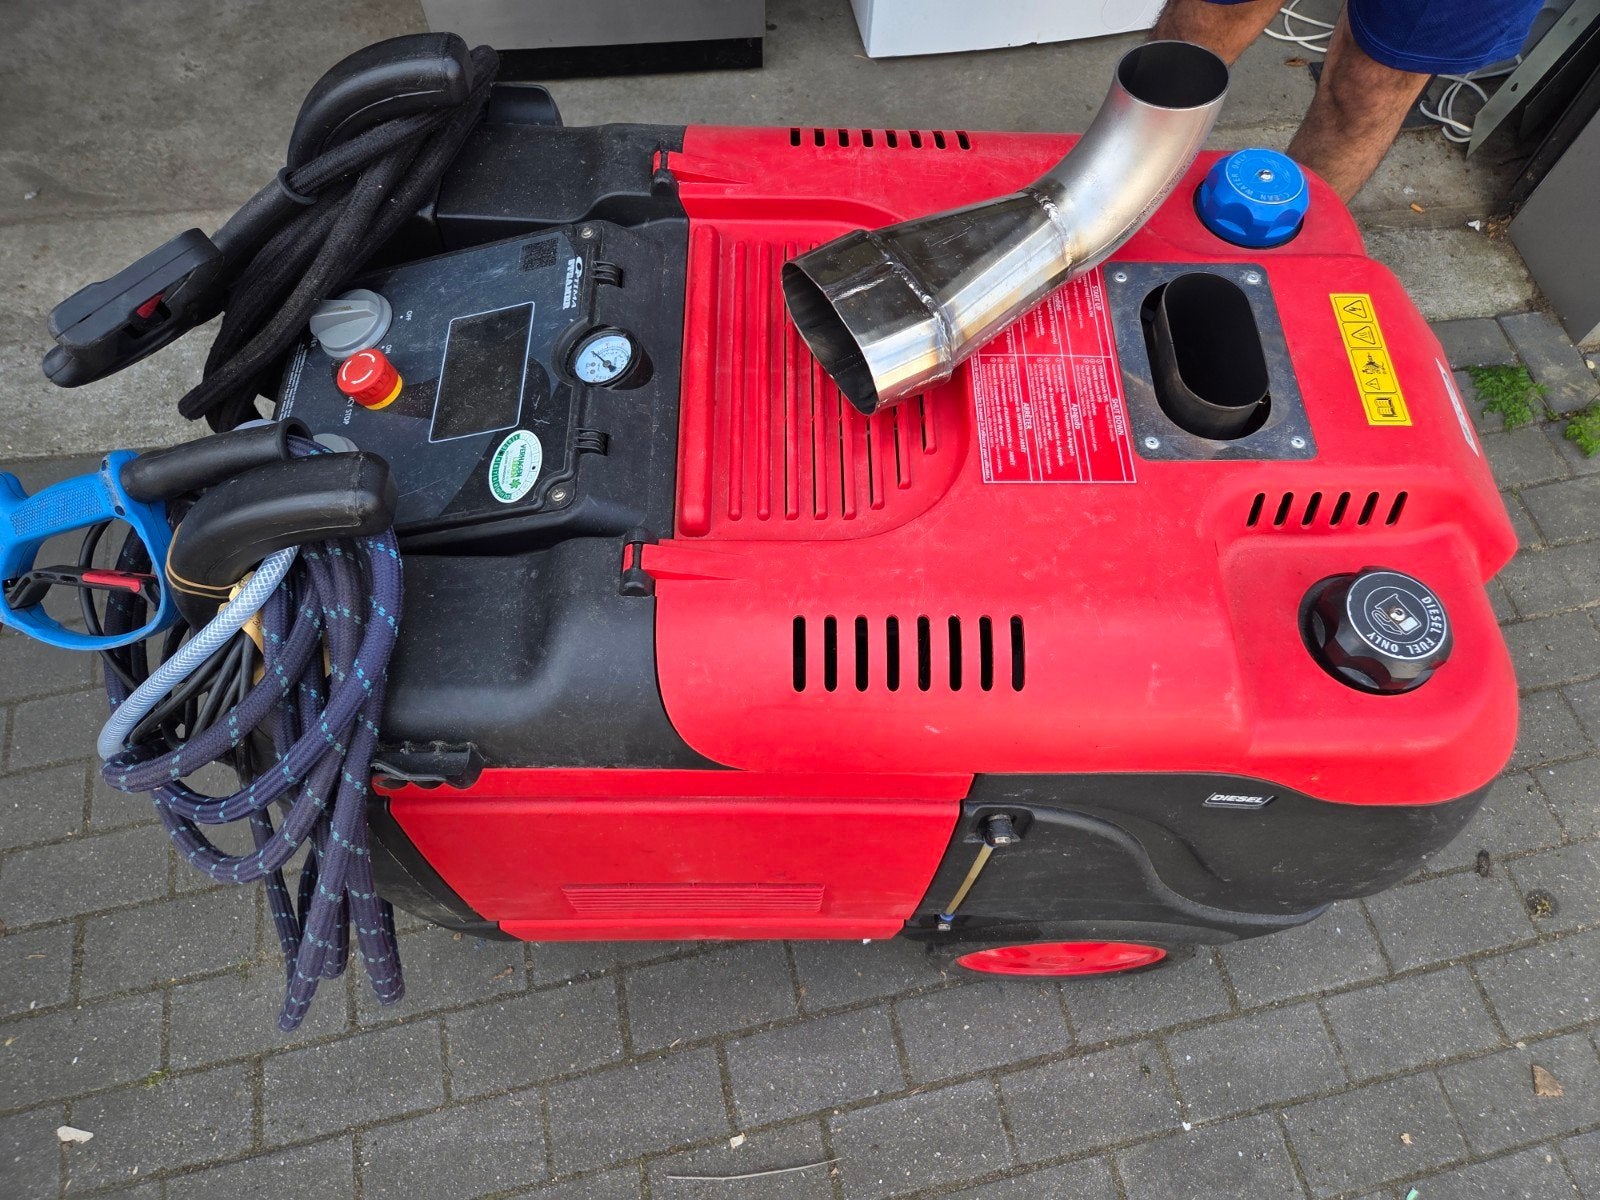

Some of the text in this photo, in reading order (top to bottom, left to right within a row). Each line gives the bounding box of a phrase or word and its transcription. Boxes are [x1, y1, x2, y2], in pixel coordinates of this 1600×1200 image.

[1232, 153, 1247, 169] ONLY
[1231, 174, 1254, 196] WATER
[1091, 285, 1102, 310] START UP
[405, 309, 413, 322] OFF
[385, 344, 393, 354] ON
[342, 408, 353, 425] STOP
[1022, 402, 1034, 429] ARRÊTER
[1070, 403, 1082, 429] Apagado
[1111, 398, 1124, 435] SHUT DOWN
[1366, 596, 1442, 655] DIESEL FUEL ONLY
[1210, 794, 1264, 803] DIESEL
